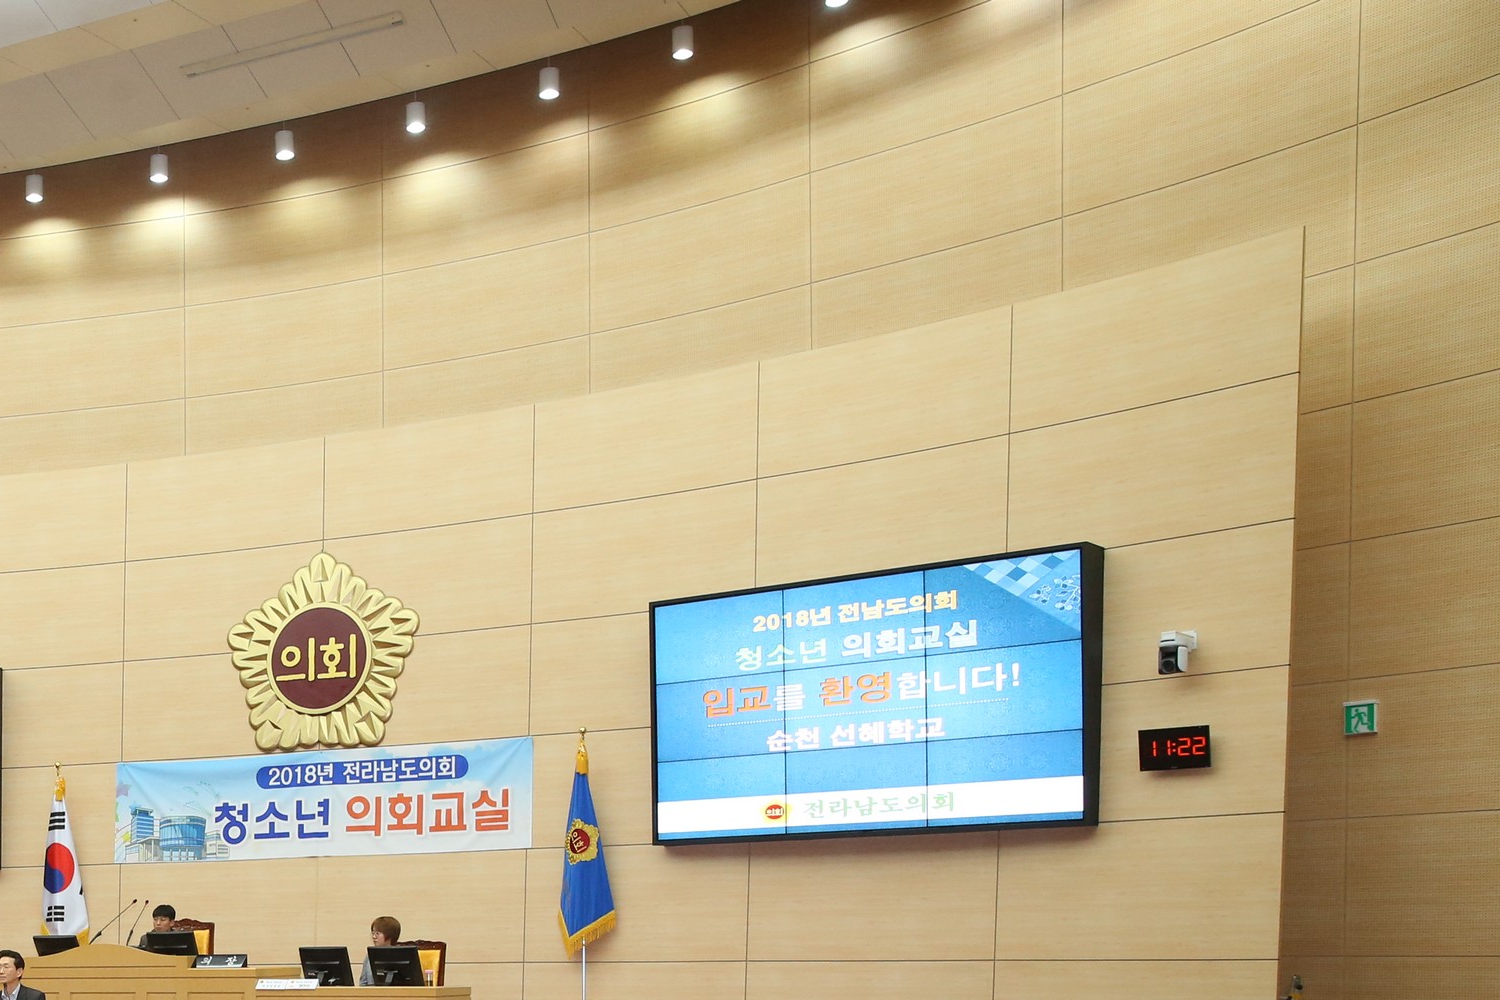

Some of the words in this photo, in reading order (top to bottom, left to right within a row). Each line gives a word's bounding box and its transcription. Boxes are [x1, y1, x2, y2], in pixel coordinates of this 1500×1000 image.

[753, 604, 832, 632] 2018년
[837, 590, 958, 624] 전남도의회
[276, 634, 357, 682] 의회
[735, 638, 827, 671] 청소년
[841, 619, 979, 658] 의회교실
[703, 683, 805, 718] 입교를
[819, 663, 1021, 707] 환영합니다!
[766, 726, 820, 753] 순천
[830, 717, 945, 748] 선혜학교
[1152, 736, 1206, 757] 11:22
[268, 762, 334, 786] 2018년
[343, 755, 456, 782] 전라남도의회
[214, 798, 330, 844] 청소년
[346, 788, 510, 836] 의회교실
[804, 792, 954, 819] 전라남도의회
